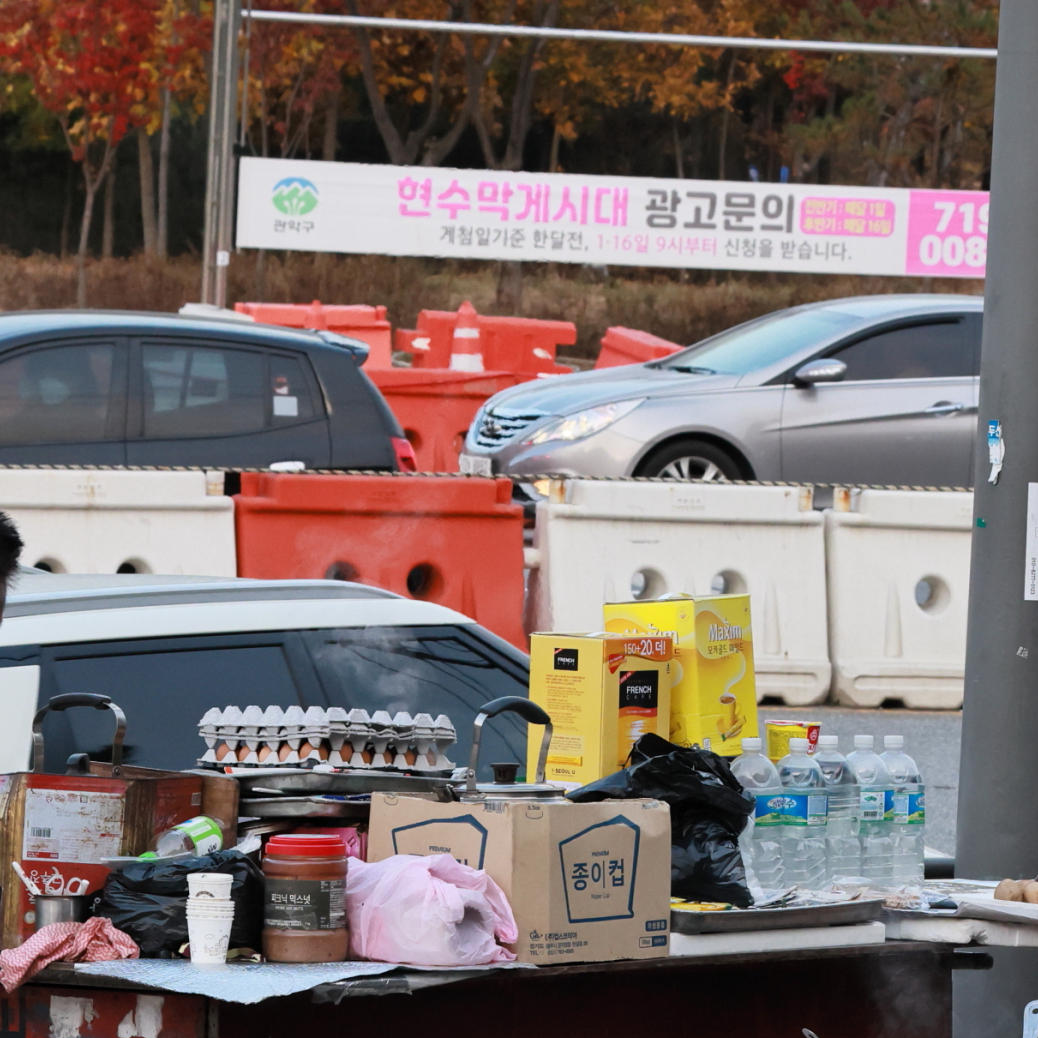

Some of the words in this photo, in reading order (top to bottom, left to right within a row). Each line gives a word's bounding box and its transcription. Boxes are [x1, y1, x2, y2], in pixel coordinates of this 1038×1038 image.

[398, 176, 629, 226] 현수막게시대
[645, 189, 795, 233] 광고문의
[274, 219, 315, 233] 관악구
[655, 235, 718, 256] 9시부터
[724, 237, 773, 259] 신청을
[780, 240, 852, 261] 받습니다.
[709, 623, 743, 642] Maxim
[626, 685, 652, 694] FRENCH
[571, 858, 625, 891] 종이컵
